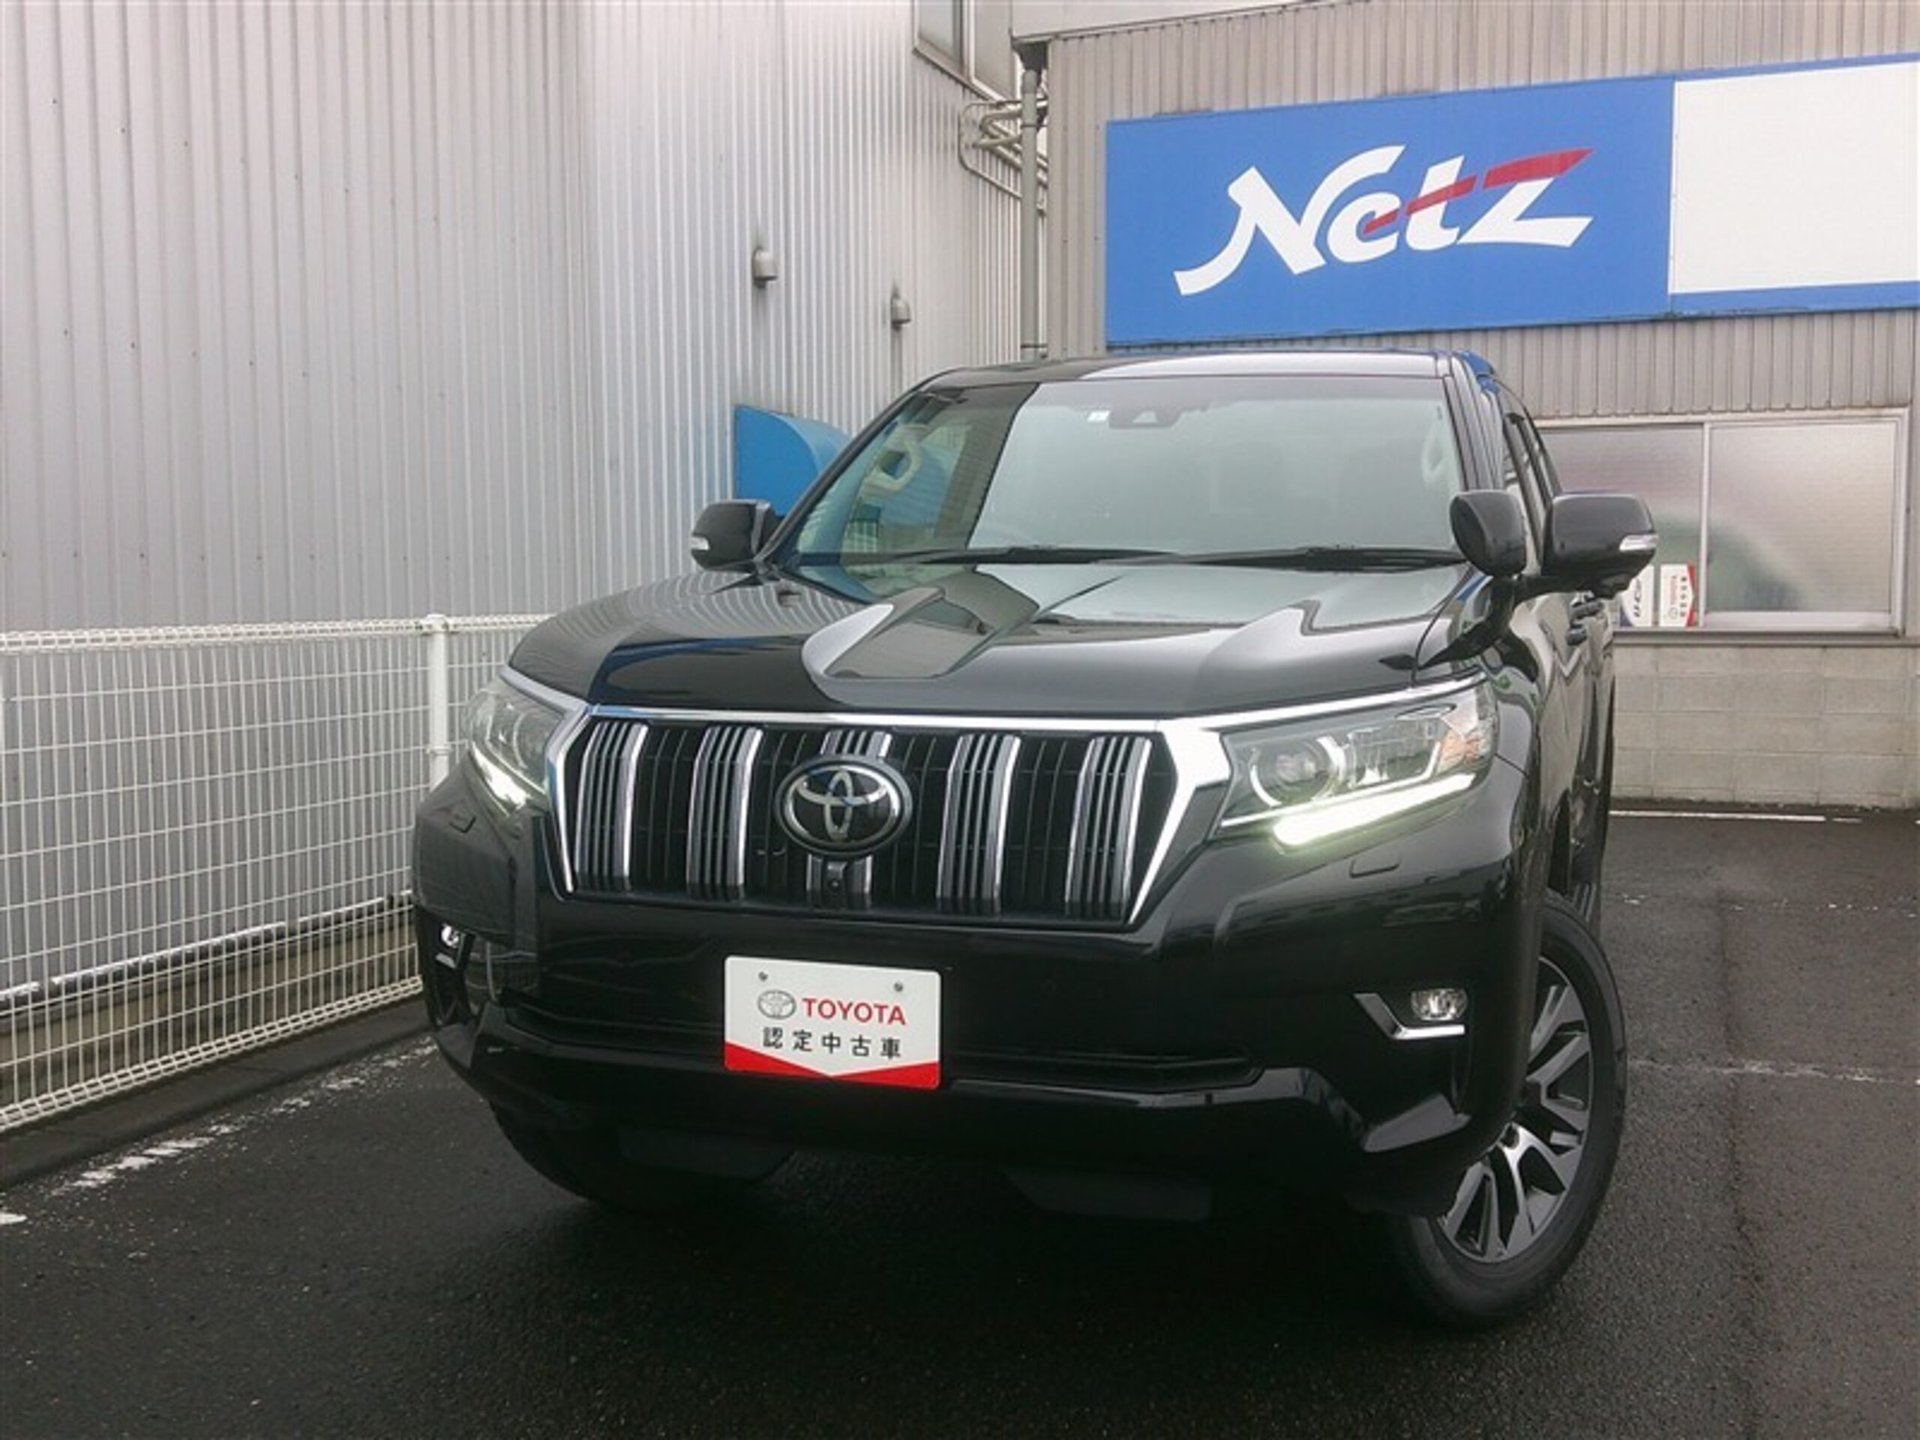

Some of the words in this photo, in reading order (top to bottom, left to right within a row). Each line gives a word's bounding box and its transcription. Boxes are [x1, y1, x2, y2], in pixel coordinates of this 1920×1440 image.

[1174, 144, 1592, 295] Netz
[802, 997, 906, 1025] TOYOTA
[762, 1026, 901, 1059] 認定中古車
